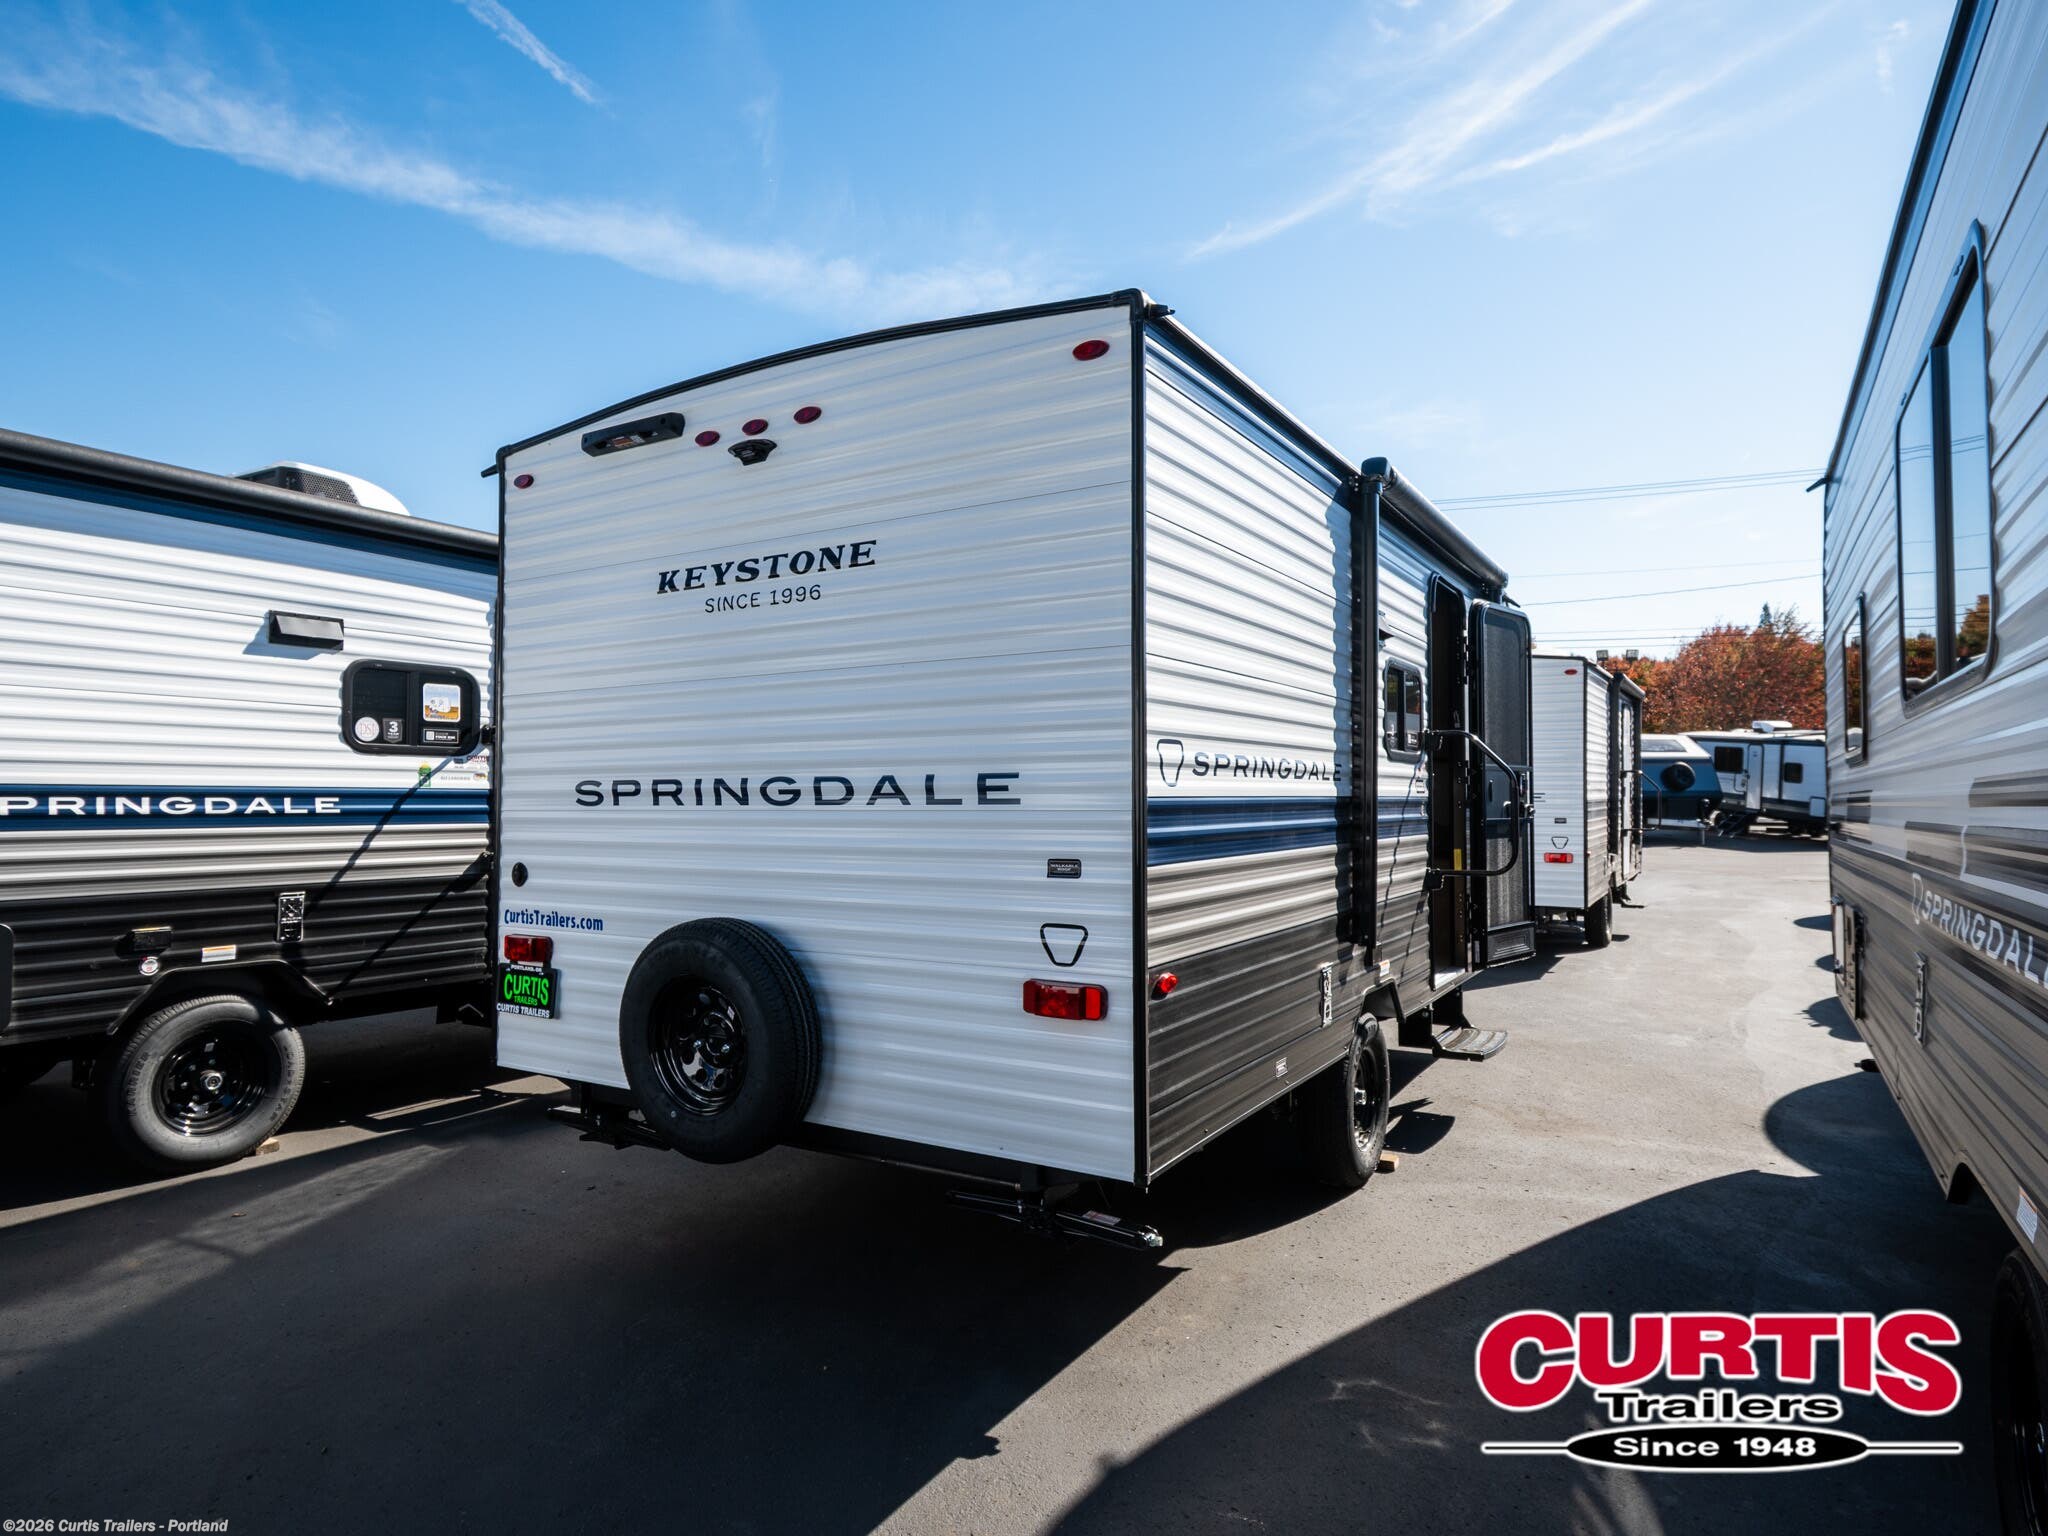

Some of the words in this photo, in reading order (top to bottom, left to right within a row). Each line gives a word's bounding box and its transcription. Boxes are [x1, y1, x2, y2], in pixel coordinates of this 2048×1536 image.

[656, 540, 877, 595] KEYSTONE
[704, 592, 761, 613] SINCE
[769, 584, 822, 606] 1996
[388, 721, 399, 733] 3
[1191, 751, 1342, 782] SPRINGDALE
[574, 772, 1022, 807] SPRINGDALE
[504, 908, 604, 931] CurtisTrailers.com
[1921, 890, 2048, 990] SPRINGDAL
[503, 973, 549, 1006] CURTIS
[513, 995, 538, 1006] TRAILERS
[496, 1002, 520, 1014] CURTIS
[520, 1006, 550, 1018] TRAILERS
